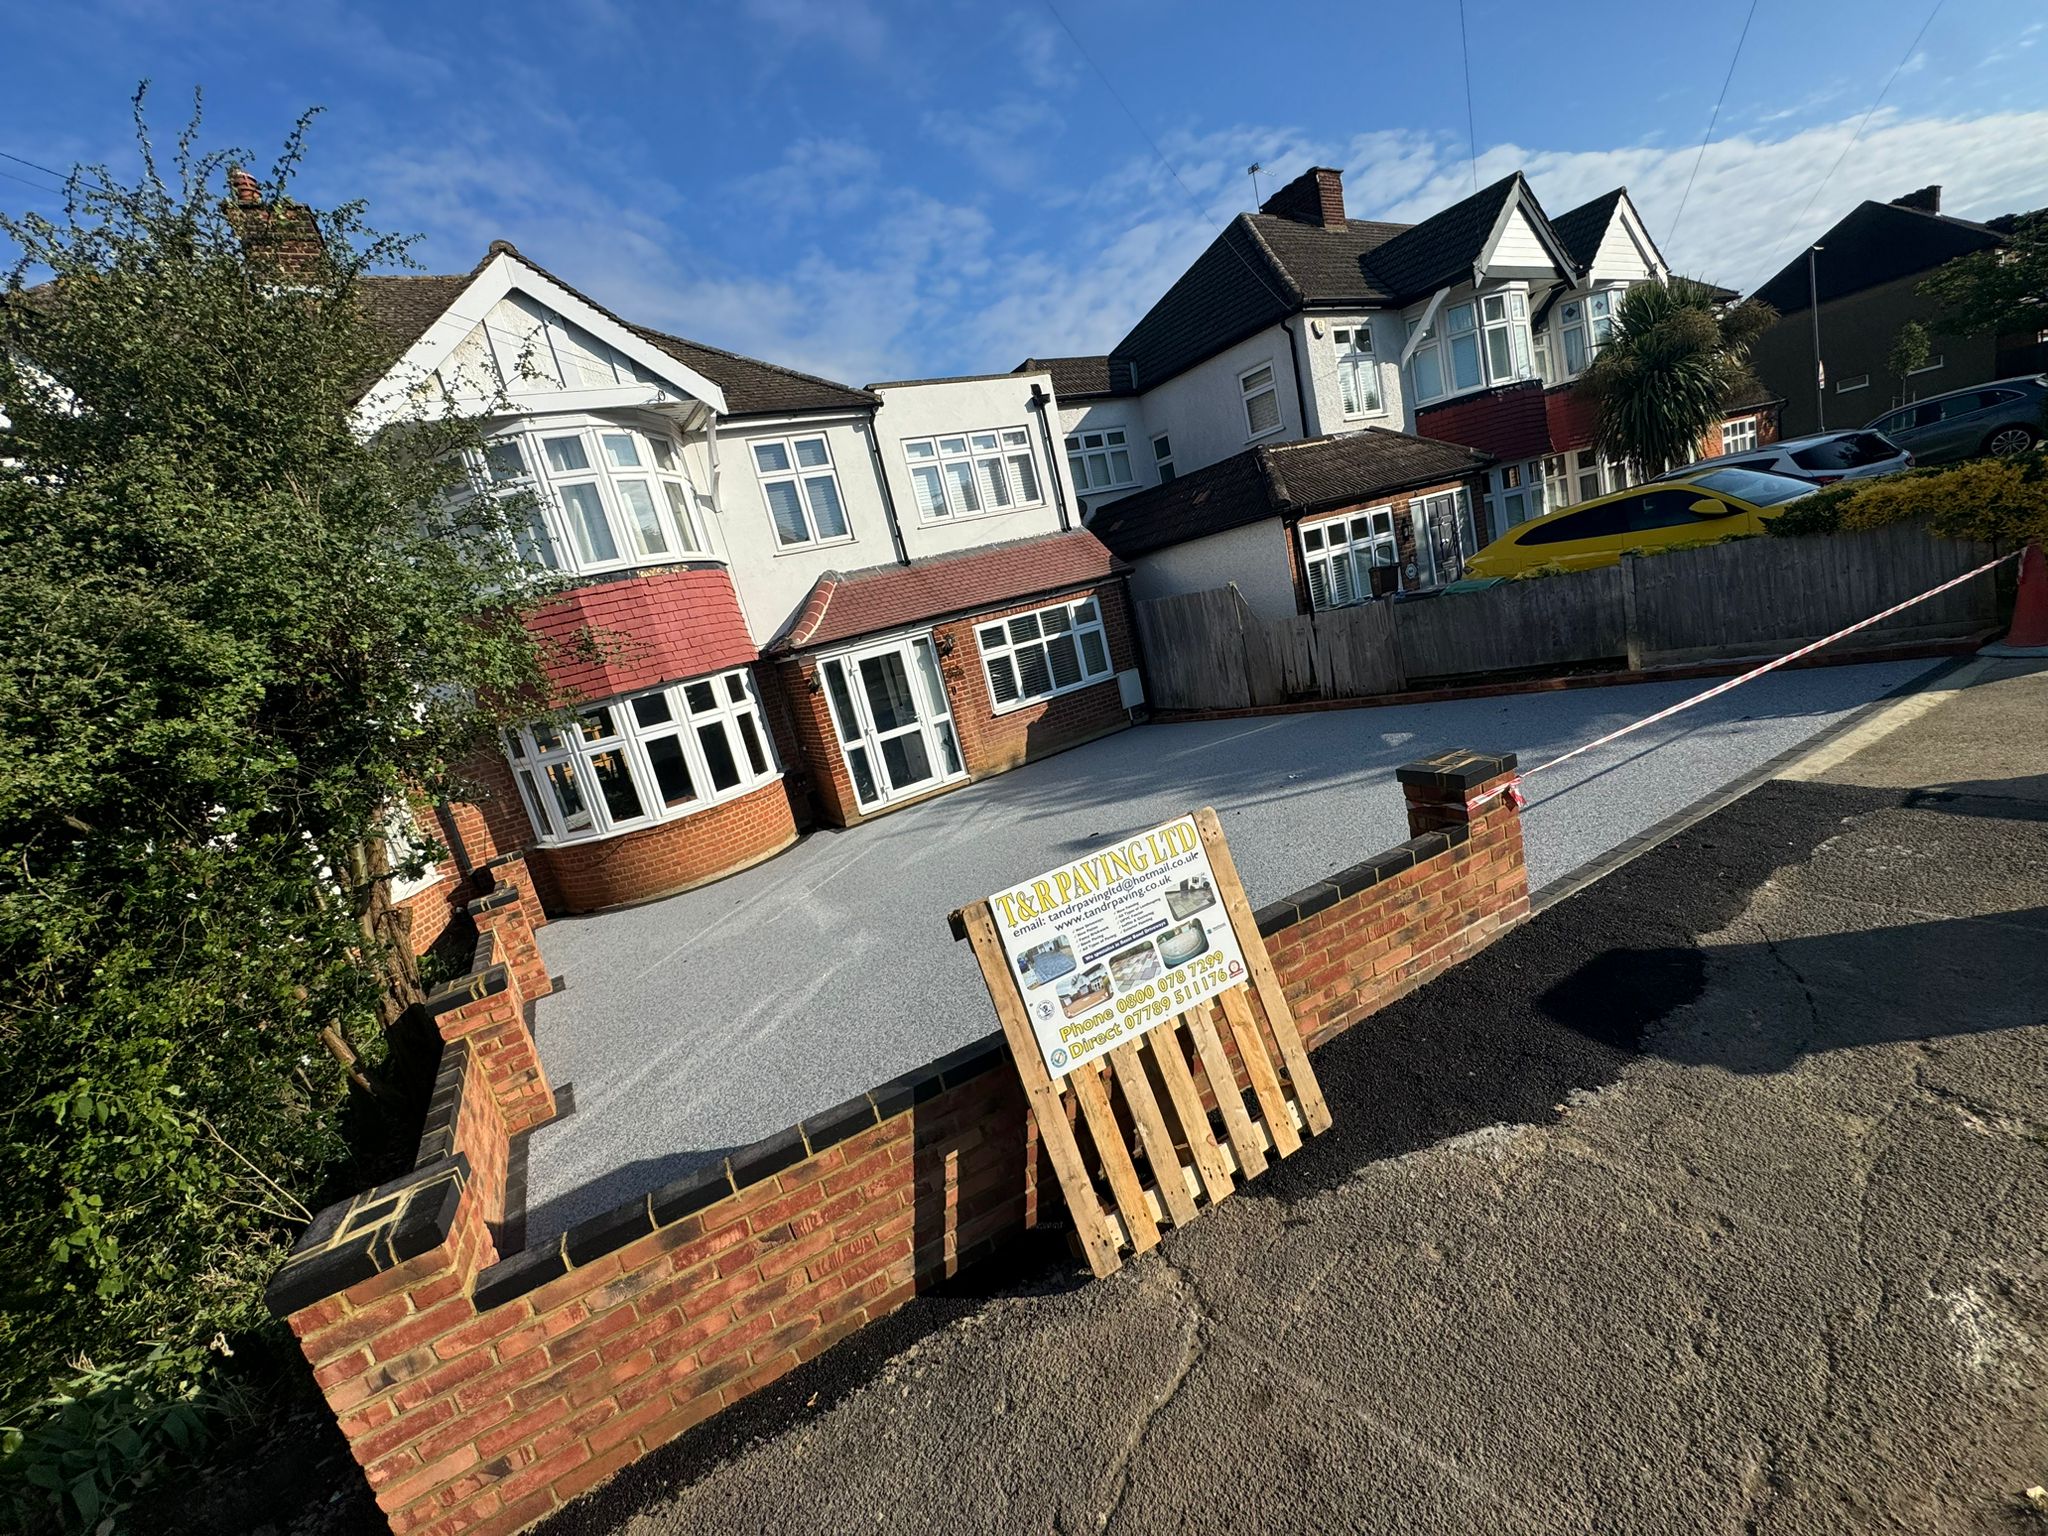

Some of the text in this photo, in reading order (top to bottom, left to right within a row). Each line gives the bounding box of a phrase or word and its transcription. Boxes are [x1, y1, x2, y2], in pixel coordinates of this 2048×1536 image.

[995, 823, 1196, 927] T&R PAVING LTD
[1013, 852, 1198, 937] email: tandrpavingltd@hotmail.co.uk
[1055, 875, 1171, 931] www.tandrpaving.co.uk
[1059, 1009, 1114, 1043] Phone
[1116, 985, 1155, 1013] 0800
[1157, 969, 1186, 993] 078
[1187, 950, 1224, 977] 7299
[1068, 1023, 1122, 1059] Direct
[1124, 996, 1171, 1030] 07789
[1174, 968, 1227, 1004] 511176
